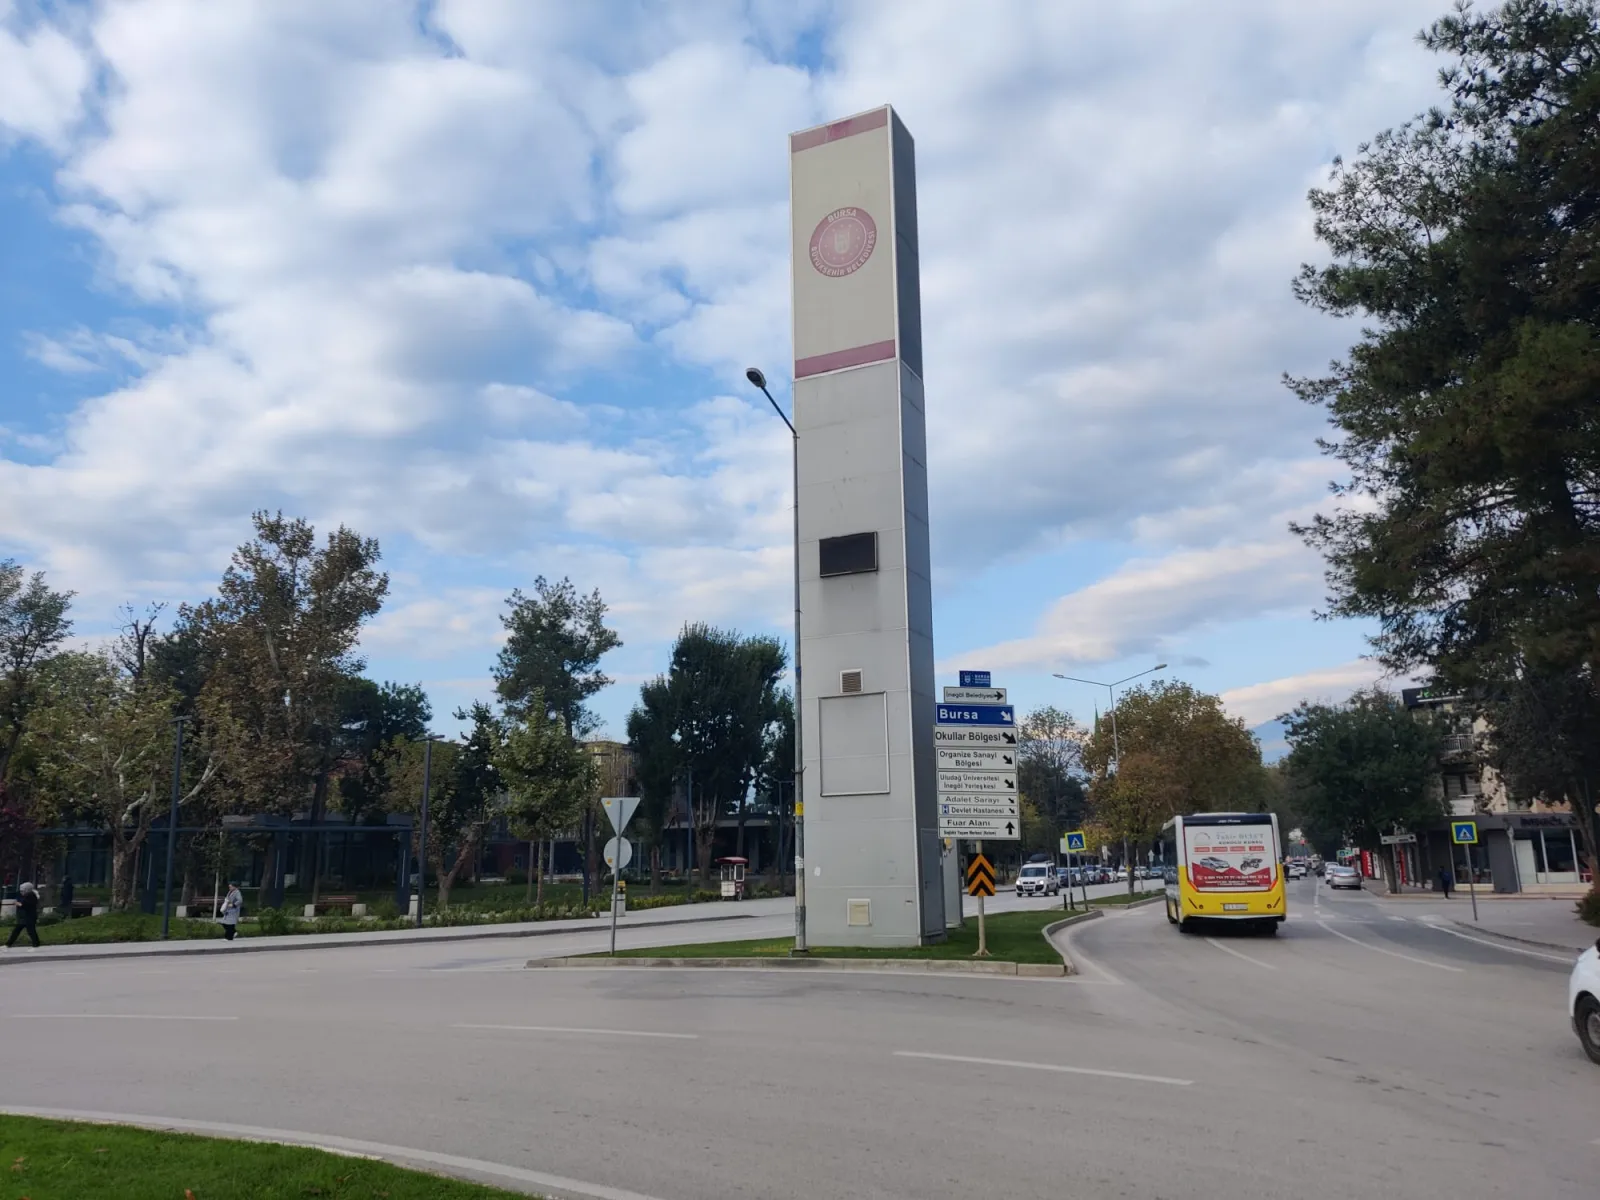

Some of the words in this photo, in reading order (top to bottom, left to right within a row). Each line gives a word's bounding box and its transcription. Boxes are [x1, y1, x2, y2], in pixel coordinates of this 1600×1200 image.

[827, 208, 857, 223] BURSA
[939, 708, 979, 720] Bursa
[935, 731, 966, 741] Okullar
[968, 731, 1001, 743] Bölgesi
[939, 750, 971, 759] Organize
[972, 751, 997, 760] Sanayi
[955, 759, 982, 768] Bölgesi
[939, 774, 962, 782] Uludağ
[943, 782, 963, 790] İnegöl
[973, 796, 1000, 804] Sarayı
[951, 806, 972, 814] Devlet
[968, 819, 991, 827] Alanı
